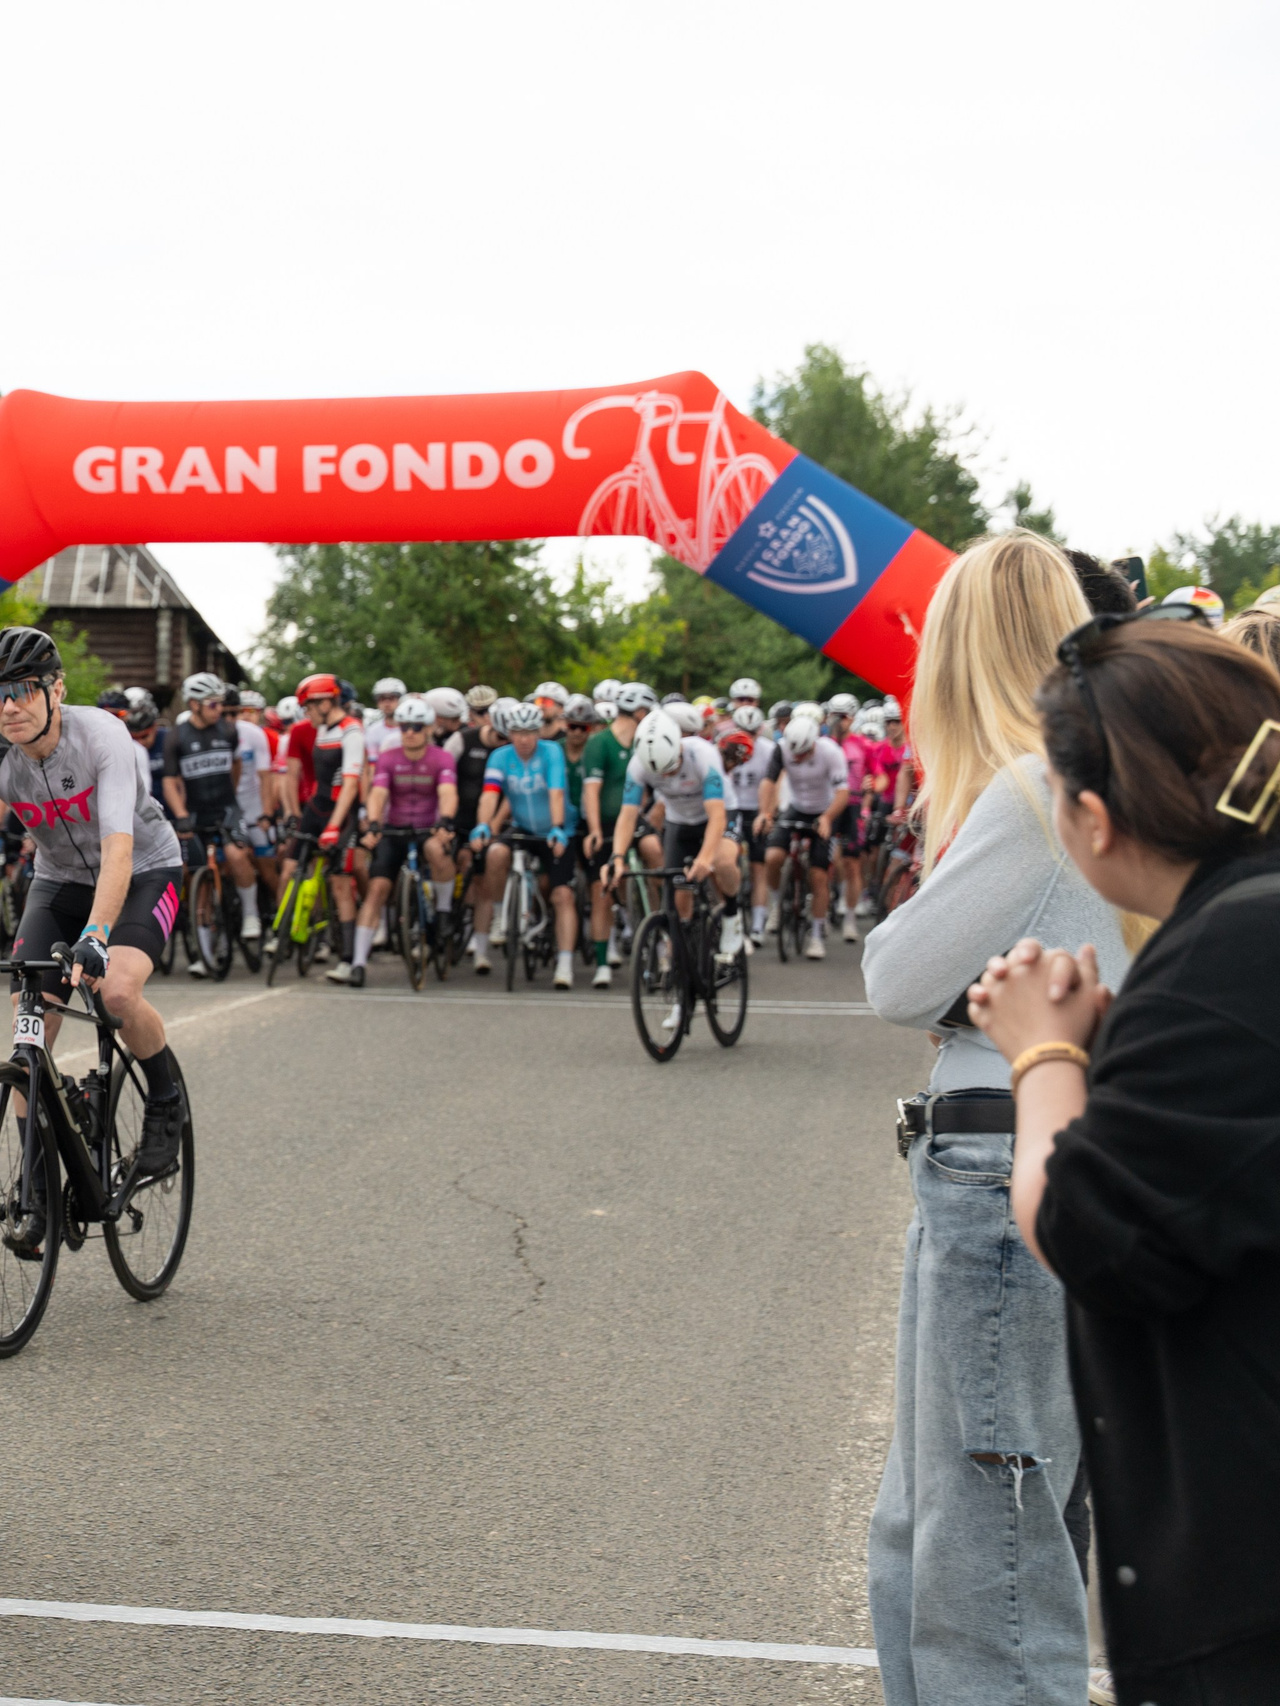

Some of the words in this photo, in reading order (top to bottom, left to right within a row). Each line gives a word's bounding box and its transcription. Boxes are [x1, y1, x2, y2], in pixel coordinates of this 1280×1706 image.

[73, 445, 277, 494] GRAN
[302, 439, 555, 493] FONDO
[761, 515, 801, 561] GRAN
[771, 519, 812, 567] FONDO
[11, 786, 94, 830] DRT
